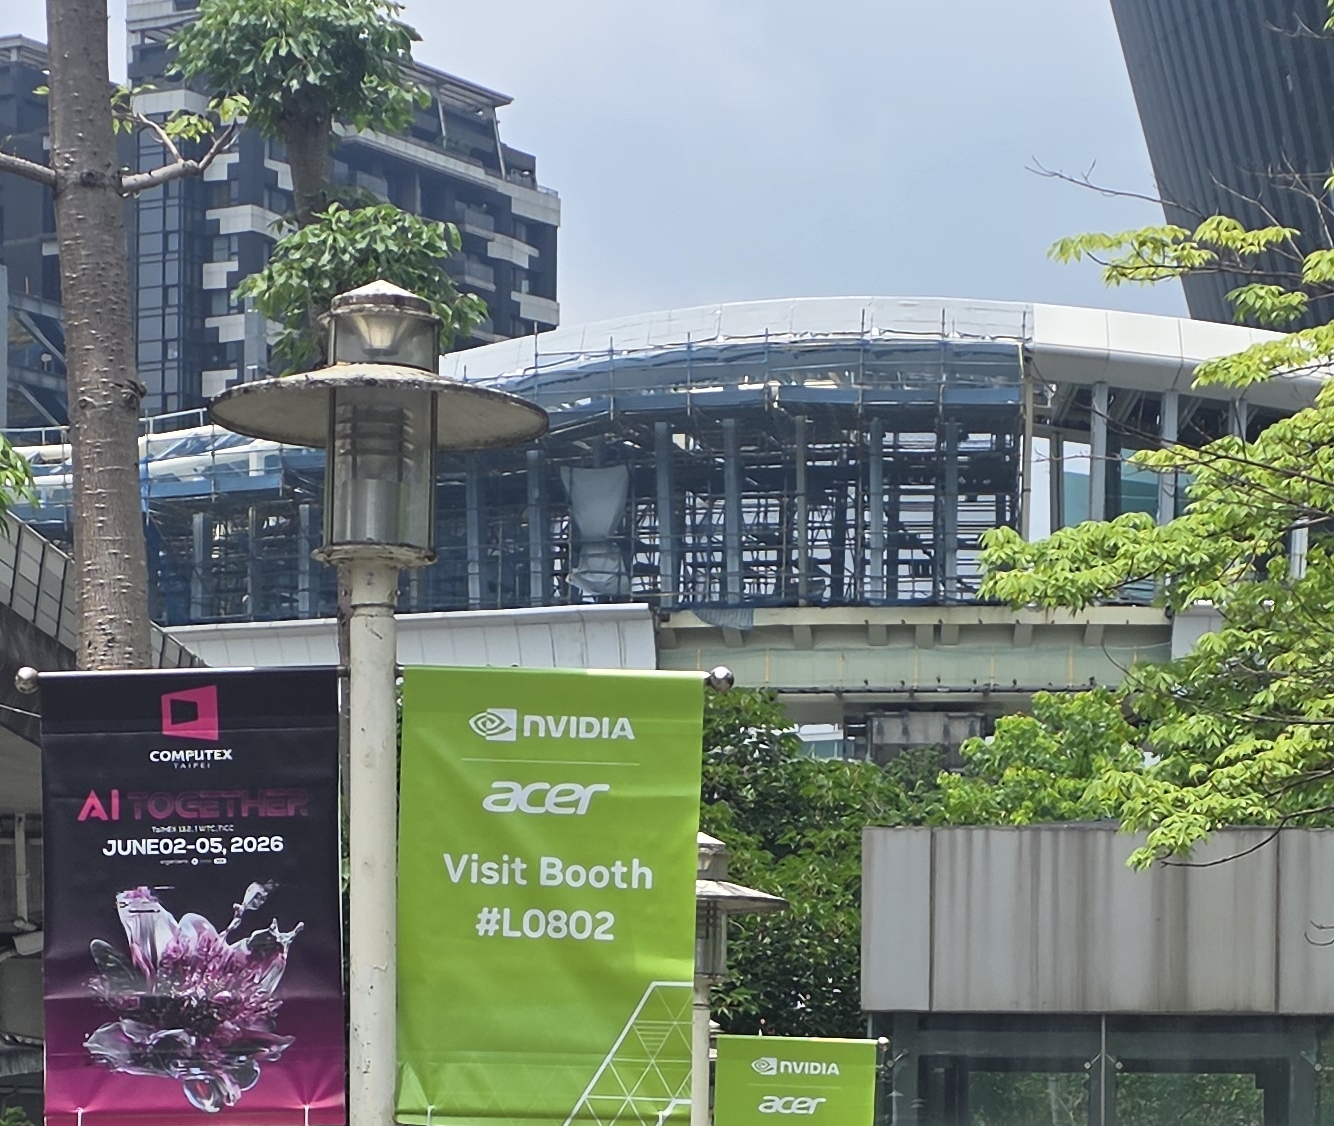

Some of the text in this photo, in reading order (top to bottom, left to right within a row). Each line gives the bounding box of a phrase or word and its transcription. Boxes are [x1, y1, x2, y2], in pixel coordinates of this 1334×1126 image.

[149, 749, 233, 762] COMPUTEX
[77, 788, 309, 821] AI TOGETHER
[482, 781, 610, 814] acer
[230, 836, 284, 853] 2026
[443, 853, 652, 889] Visit Booth
[475, 907, 615, 940] #L0802
[758, 1095, 827, 1115] acer
